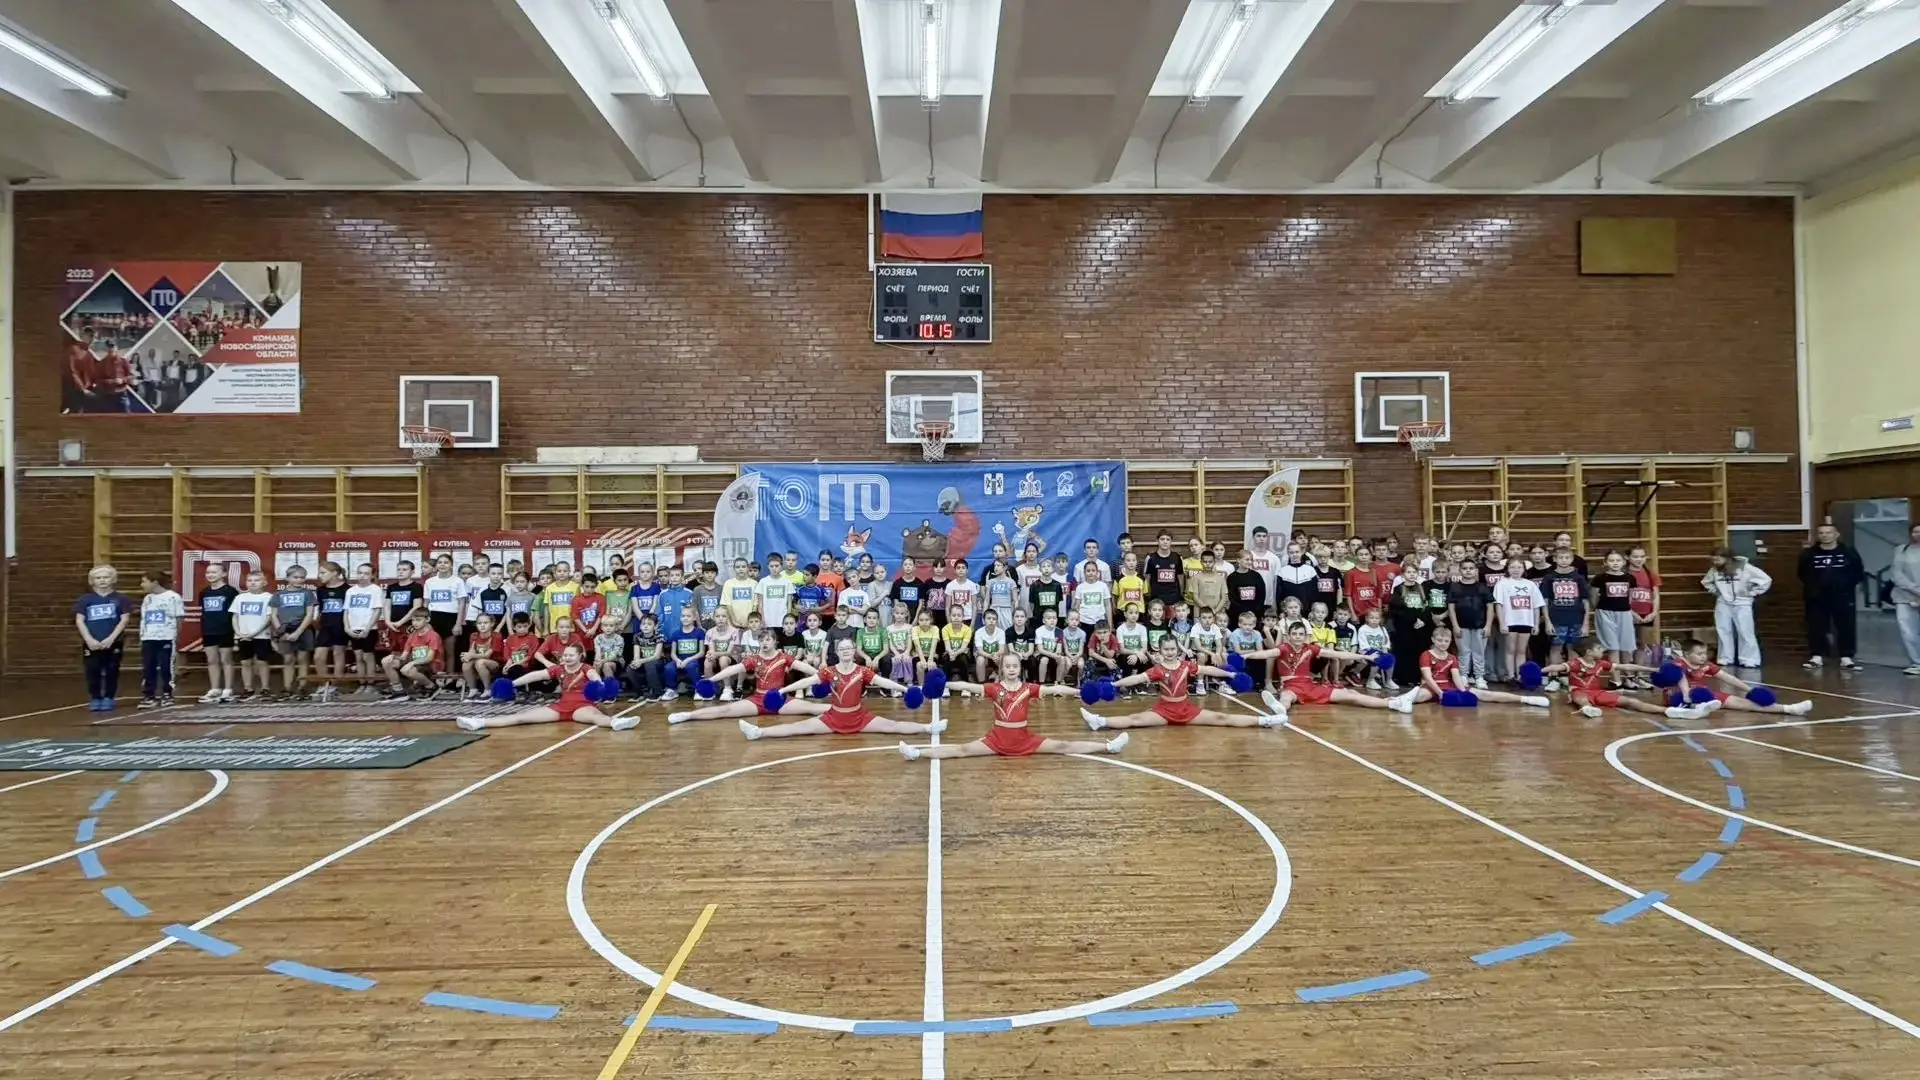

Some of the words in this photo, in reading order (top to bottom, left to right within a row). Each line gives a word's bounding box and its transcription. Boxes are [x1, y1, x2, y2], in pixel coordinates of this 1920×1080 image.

[66, 268, 94, 278] 2023
[878, 268, 918, 276] ХОЗЯЕВА
[956, 268, 985, 276] ГОСТИ
[885, 284, 905, 293] СЧЁТ
[917, 285, 949, 293] ПЕРИОД
[960, 285, 980, 293] СЧЁТ
[151, 289, 177, 306] ГТО
[220, 342, 297, 350] НОВОСИБИРСКОЙ
[819, 474, 890, 521] ГТО
[722, 537, 749, 558] ГТО
[735, 589, 750, 597] 173
[1556, 585, 1574, 593] 022
[283, 596, 301, 604] 122
[433, 592, 449, 600] 182
[352, 597, 368, 605] 179
[90, 606, 112, 617] 134
